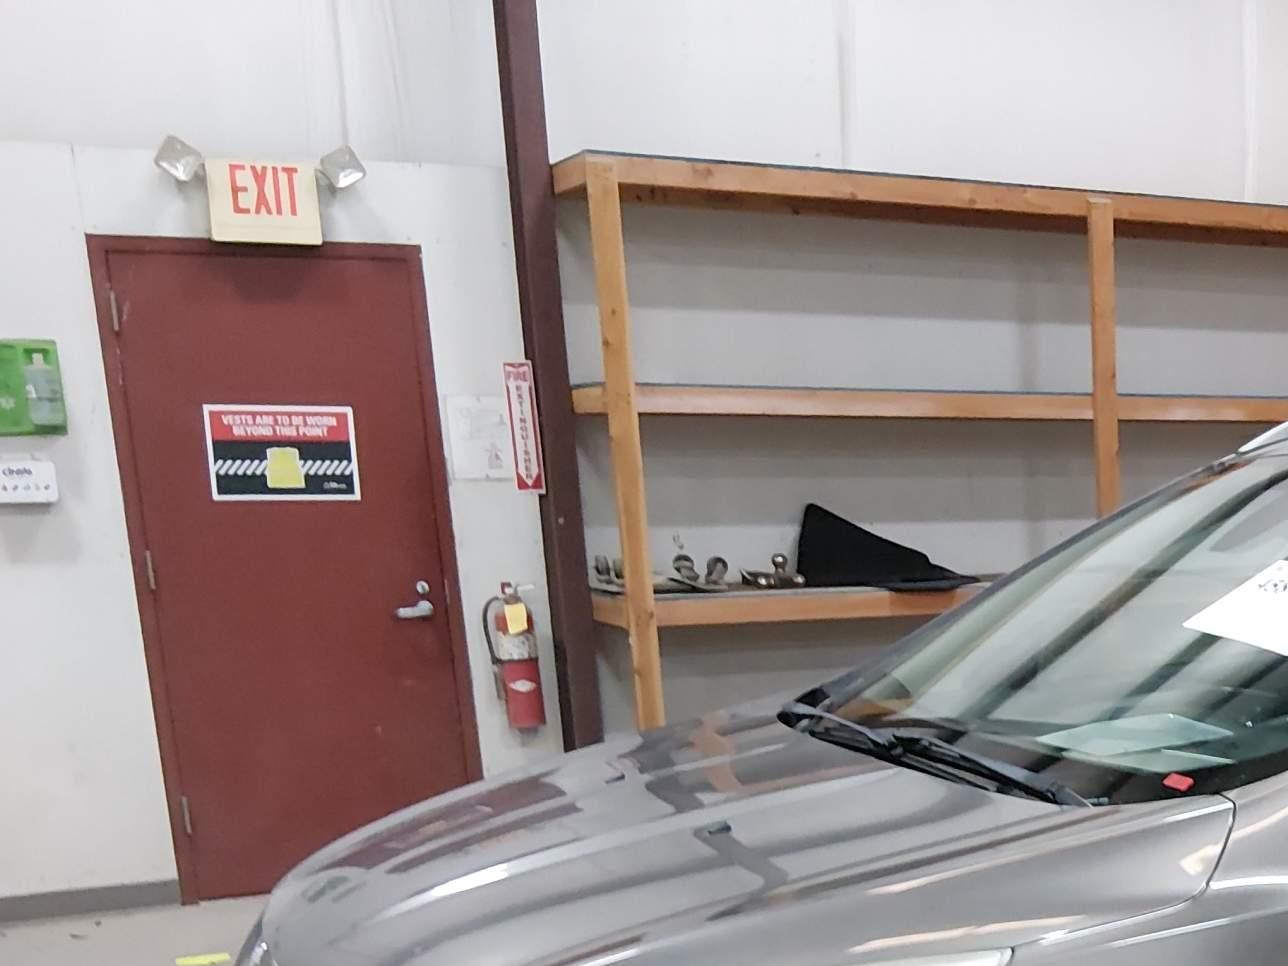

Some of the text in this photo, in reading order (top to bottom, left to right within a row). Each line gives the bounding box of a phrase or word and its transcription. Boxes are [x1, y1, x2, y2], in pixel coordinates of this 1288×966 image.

[228, 163, 298, 216] EXIT
[506, 370, 528, 382] FIRE
[221, 414, 337, 427] VESTS ARE TO BE WORN
[232, 426, 329, 437] BEYOND THIS POINT
[515, 384, 533, 480] EXTINGUISHER
